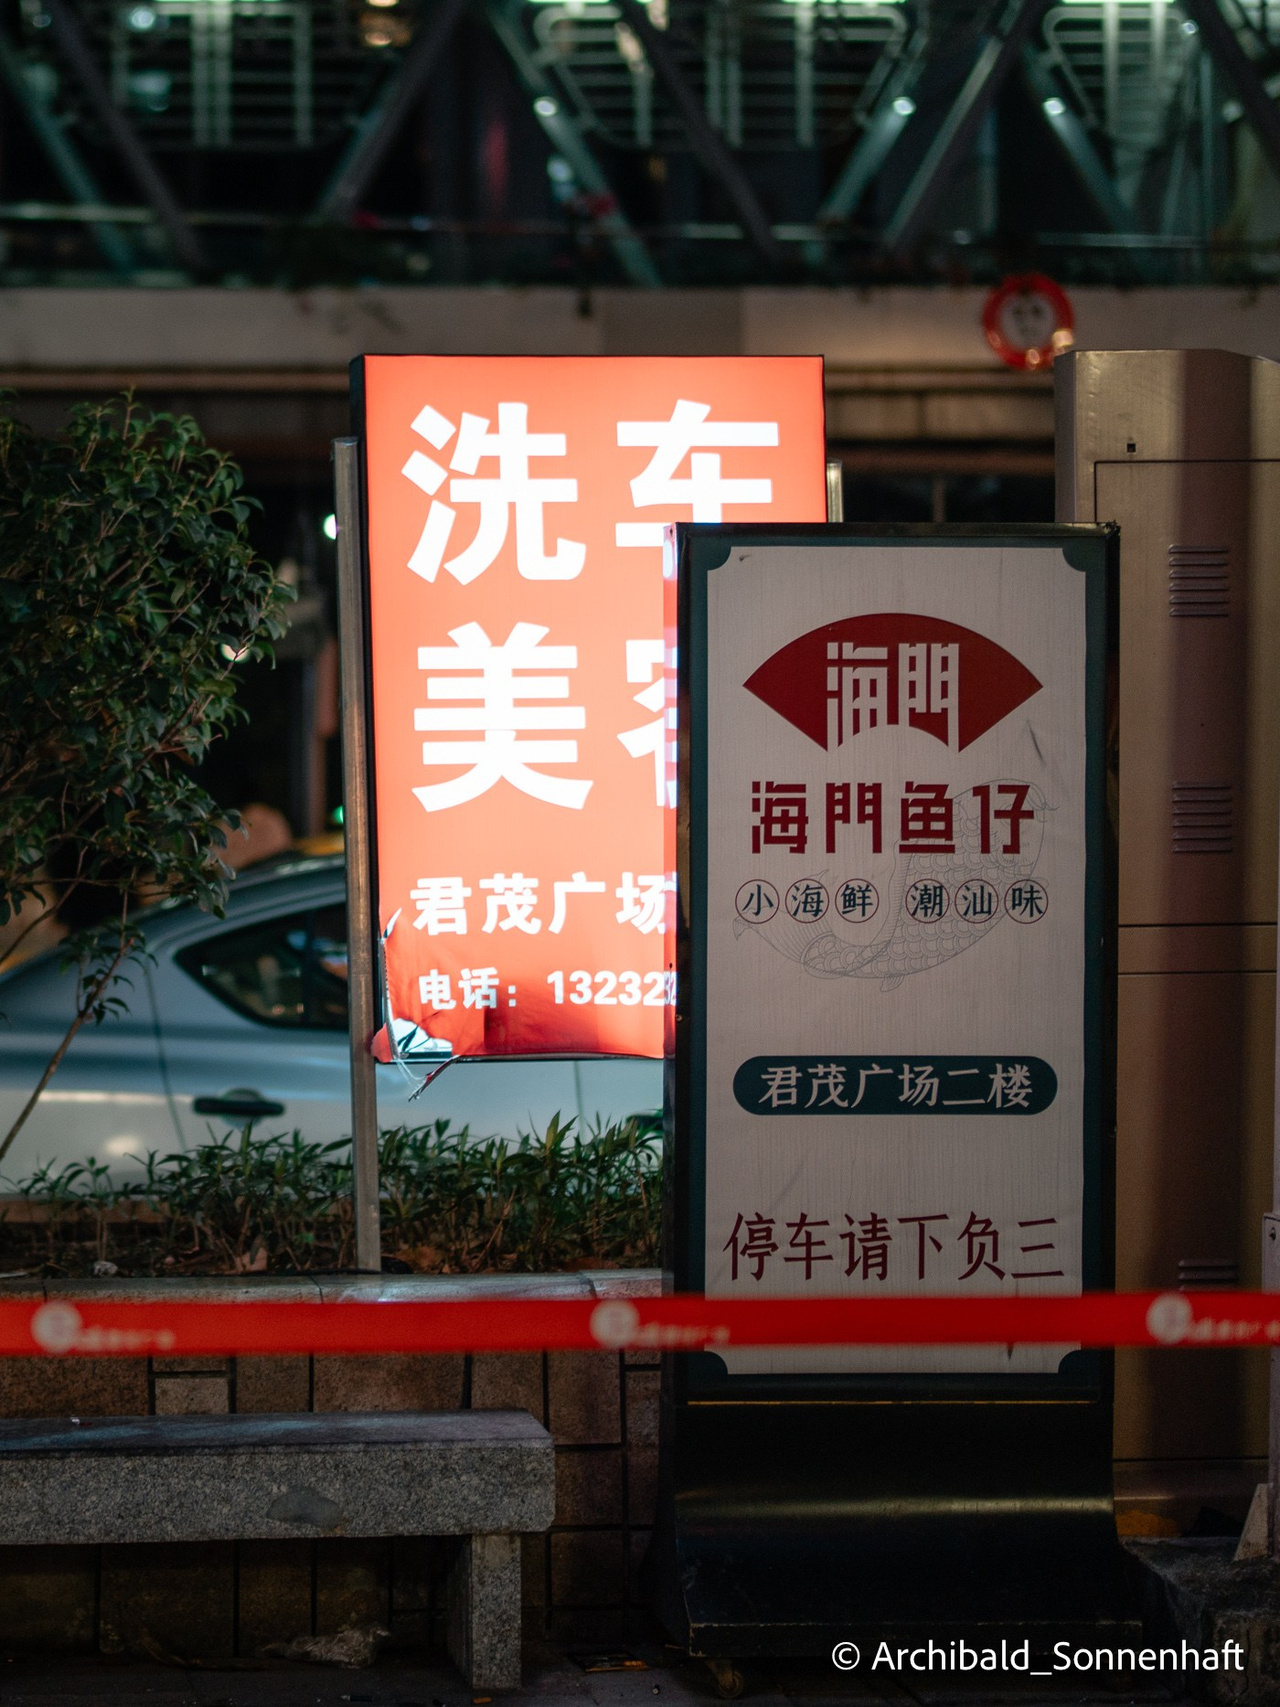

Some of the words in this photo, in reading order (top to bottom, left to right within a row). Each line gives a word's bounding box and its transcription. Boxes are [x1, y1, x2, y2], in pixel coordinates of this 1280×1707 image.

[410, 871, 666, 936] 君茂广场
[758, 1063, 1033, 1109] 君茂广场二楼
[722, 1211, 1065, 1282] 停车请下负三
